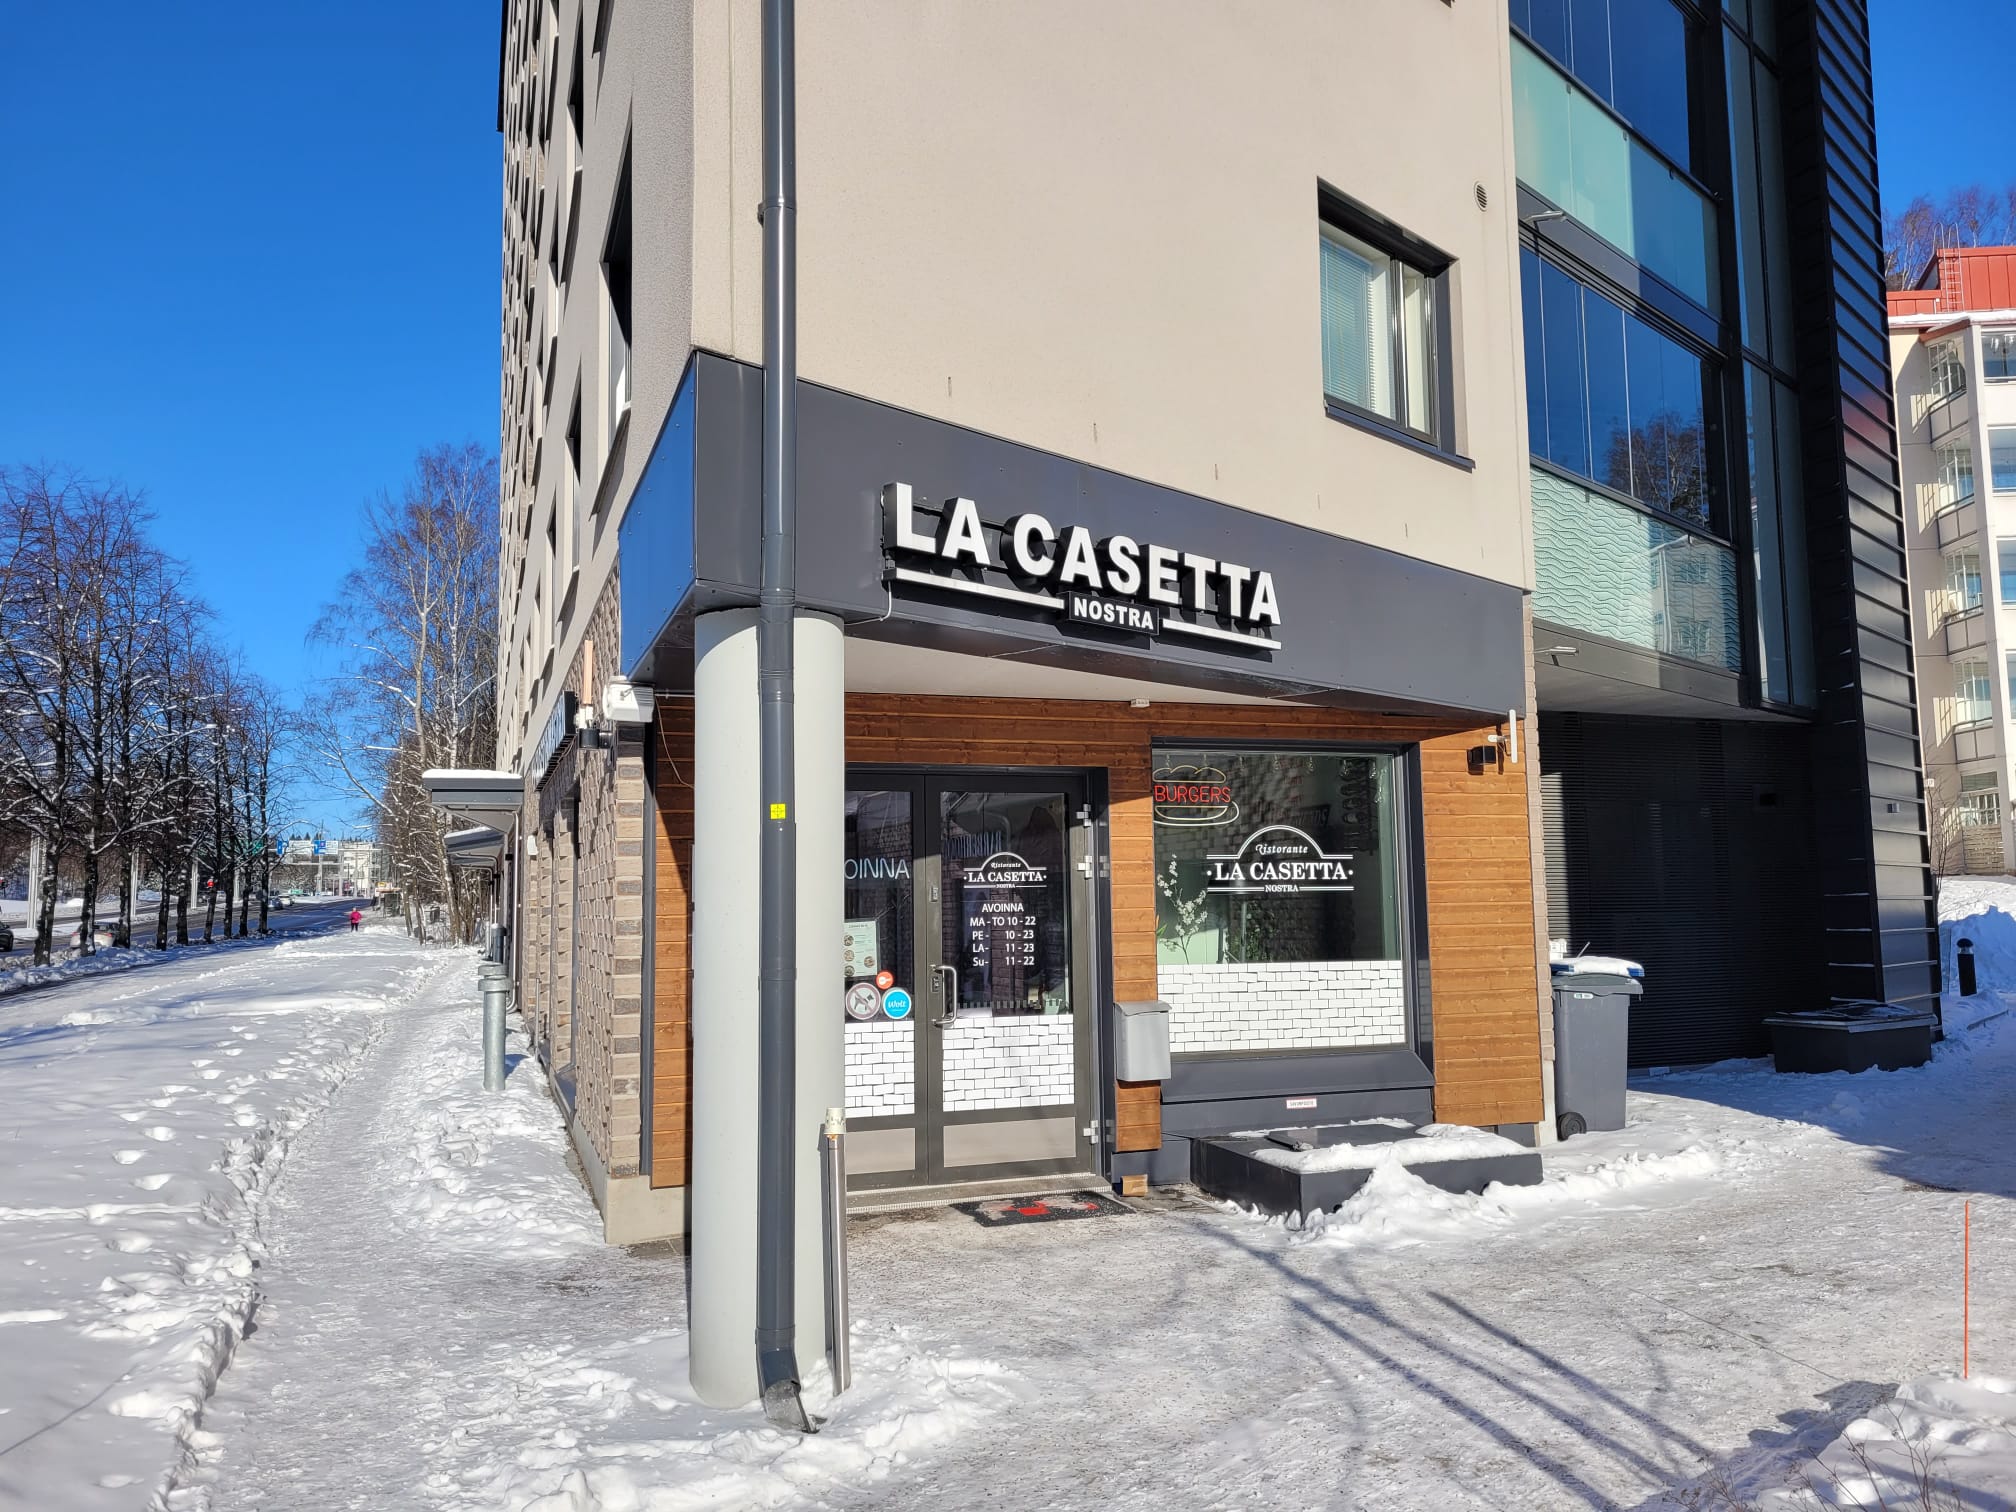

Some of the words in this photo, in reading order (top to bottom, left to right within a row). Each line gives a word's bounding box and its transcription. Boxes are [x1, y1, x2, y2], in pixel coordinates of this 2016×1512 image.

[896, 482, 991, 566] LA
[1012, 512, 1282, 626] CASETTA
[1073, 596, 1154, 631] NOSTRA
[1153, 785, 1231, 803] BURGERS
[1255, 844, 1308, 855] Ristorante
[968, 872, 986, 883] LA
[987, 871, 1043, 882] CASETTA
[1215, 862, 1245, 881] LA
[1249, 862, 1348, 881] CASETTA
[1265, 884, 1299, 892] NOSTRA
[981, 903, 1024, 913] AVOINNA
[969, 916, 986, 927] MA
[991, 916, 1005, 926] TO
[1007, 916, 1018, 926] 10
[1024, 916, 1037, 926] 22
[972, 930, 984, 940] PE
[1005, 930, 1015, 940] 10
[1023, 929, 1034, 939] 23
[1005, 943, 1015, 953] 11
[1023, 943, 1034, 953] 23
[1005, 956, 1015, 966] 11
[1023, 956, 1035, 966] 22
[887, 1000, 906, 1009] Wolt
